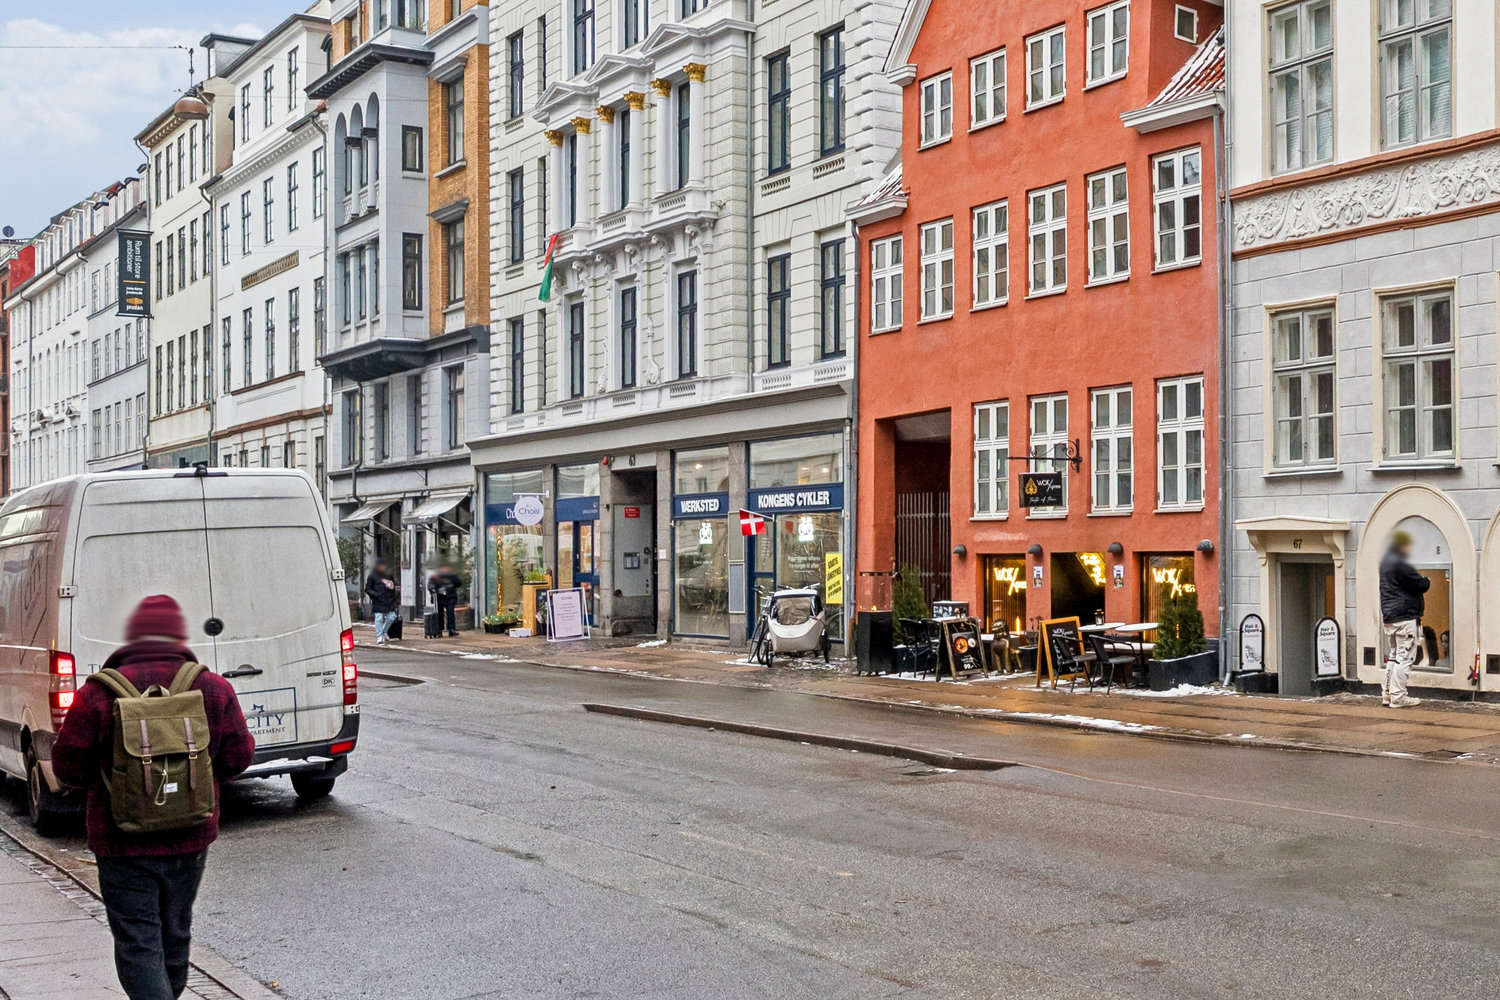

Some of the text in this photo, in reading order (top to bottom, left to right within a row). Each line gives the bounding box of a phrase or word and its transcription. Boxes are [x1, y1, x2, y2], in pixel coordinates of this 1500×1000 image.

[126, 239, 135, 273] ambitioner
[134, 240, 143, 256] Rum
[680, 498, 720, 513] VÆRKSTED
[757, 490, 830, 509] KONGENS CYKLER
[1293, 538, 1302, 549] 67
[993, 566, 1015, 582] WOK
[1152, 567, 1177, 584] WOK
[246, 713, 285, 728] CITY
